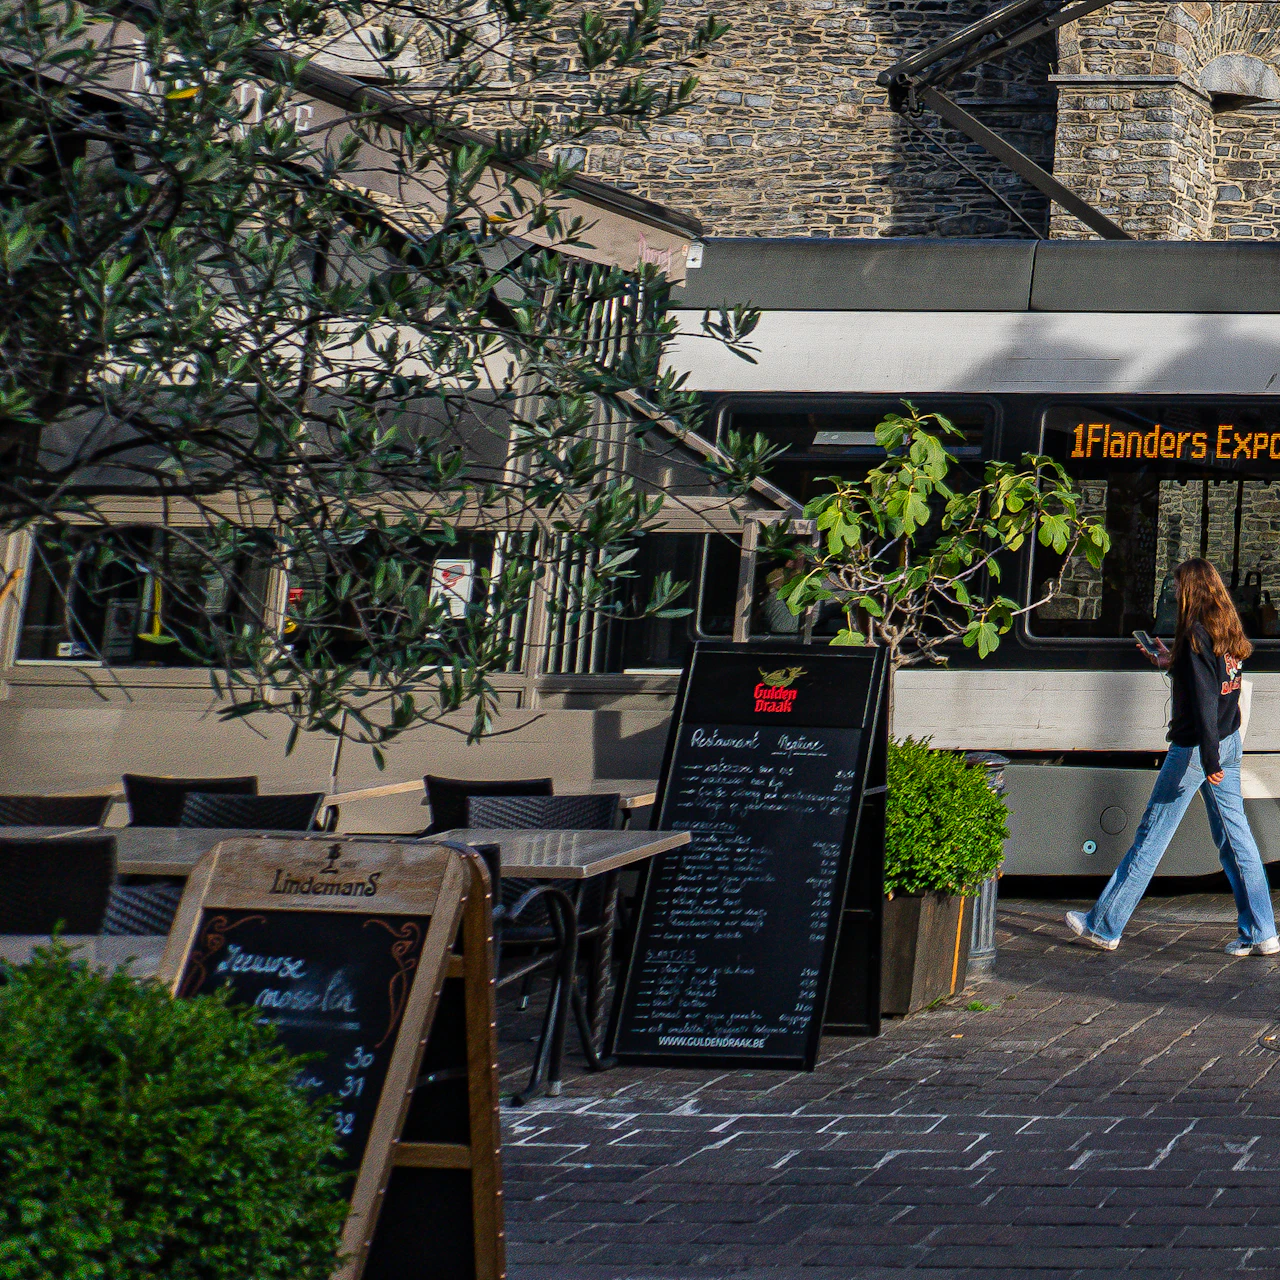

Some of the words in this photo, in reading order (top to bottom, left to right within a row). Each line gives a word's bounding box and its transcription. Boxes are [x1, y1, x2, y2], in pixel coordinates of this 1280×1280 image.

[753, 682, 799, 701] Gulden
[753, 700, 793, 713] Draak
[690, 728, 761, 750] Restaurant
[657, 1035, 766, 1049] WWW.GULDENDRAAK.BE
[344, 1045, 376, 1070] 30
[338, 1075, 367, 1098] 31
[333, 1111, 356, 1135] 32
